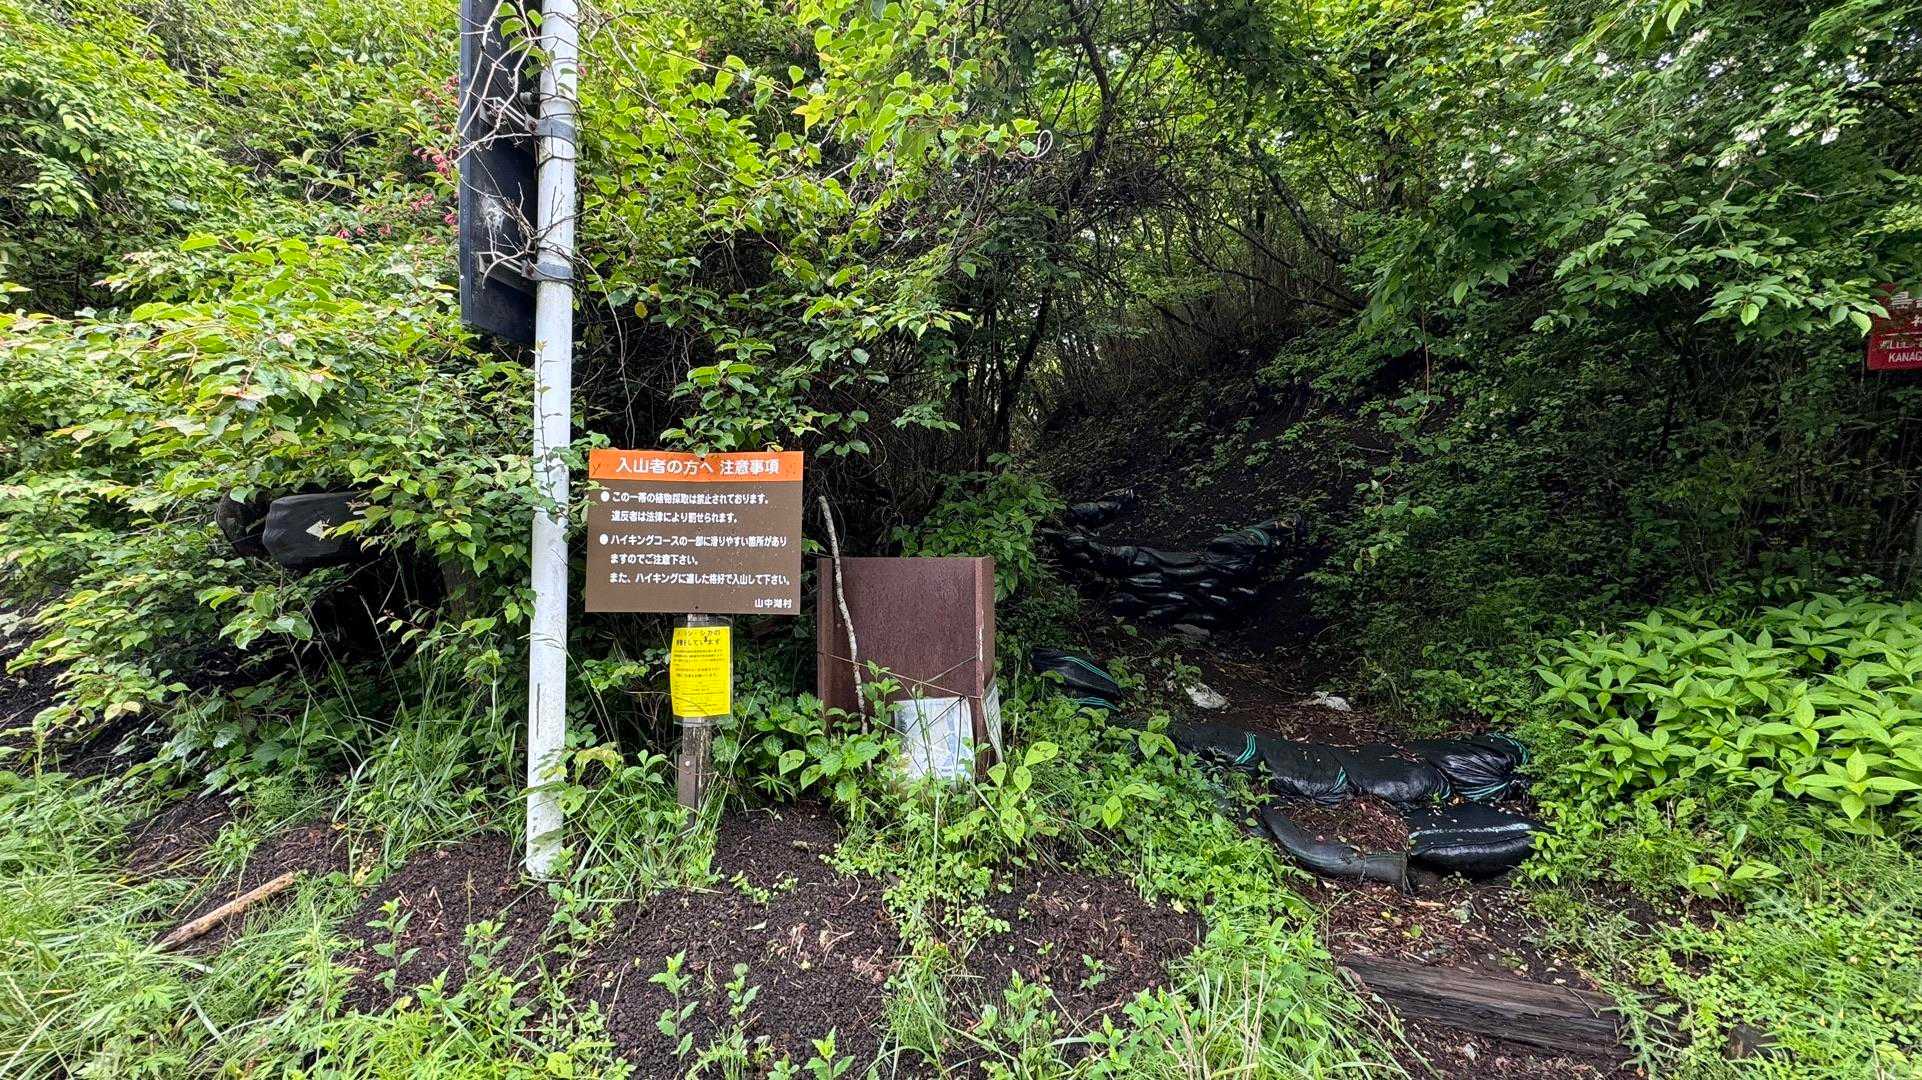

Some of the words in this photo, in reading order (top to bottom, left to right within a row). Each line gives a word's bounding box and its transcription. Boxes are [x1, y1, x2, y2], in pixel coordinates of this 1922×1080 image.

[615, 457, 715, 476] 入山者の方へ
[719, 458, 780, 476] 注意事項
[611, 510, 739, 524] 違反者は法律により罰せられます。
[611, 534, 787, 547] ハイキングコースの一部に滑りやすい箇所があり
[610, 553, 699, 566] ますのでご注意下さい。
[609, 572, 790, 586] また、ハイキングに適した格好で入山して下さい。
[754, 598, 792, 608] 山中湖村
